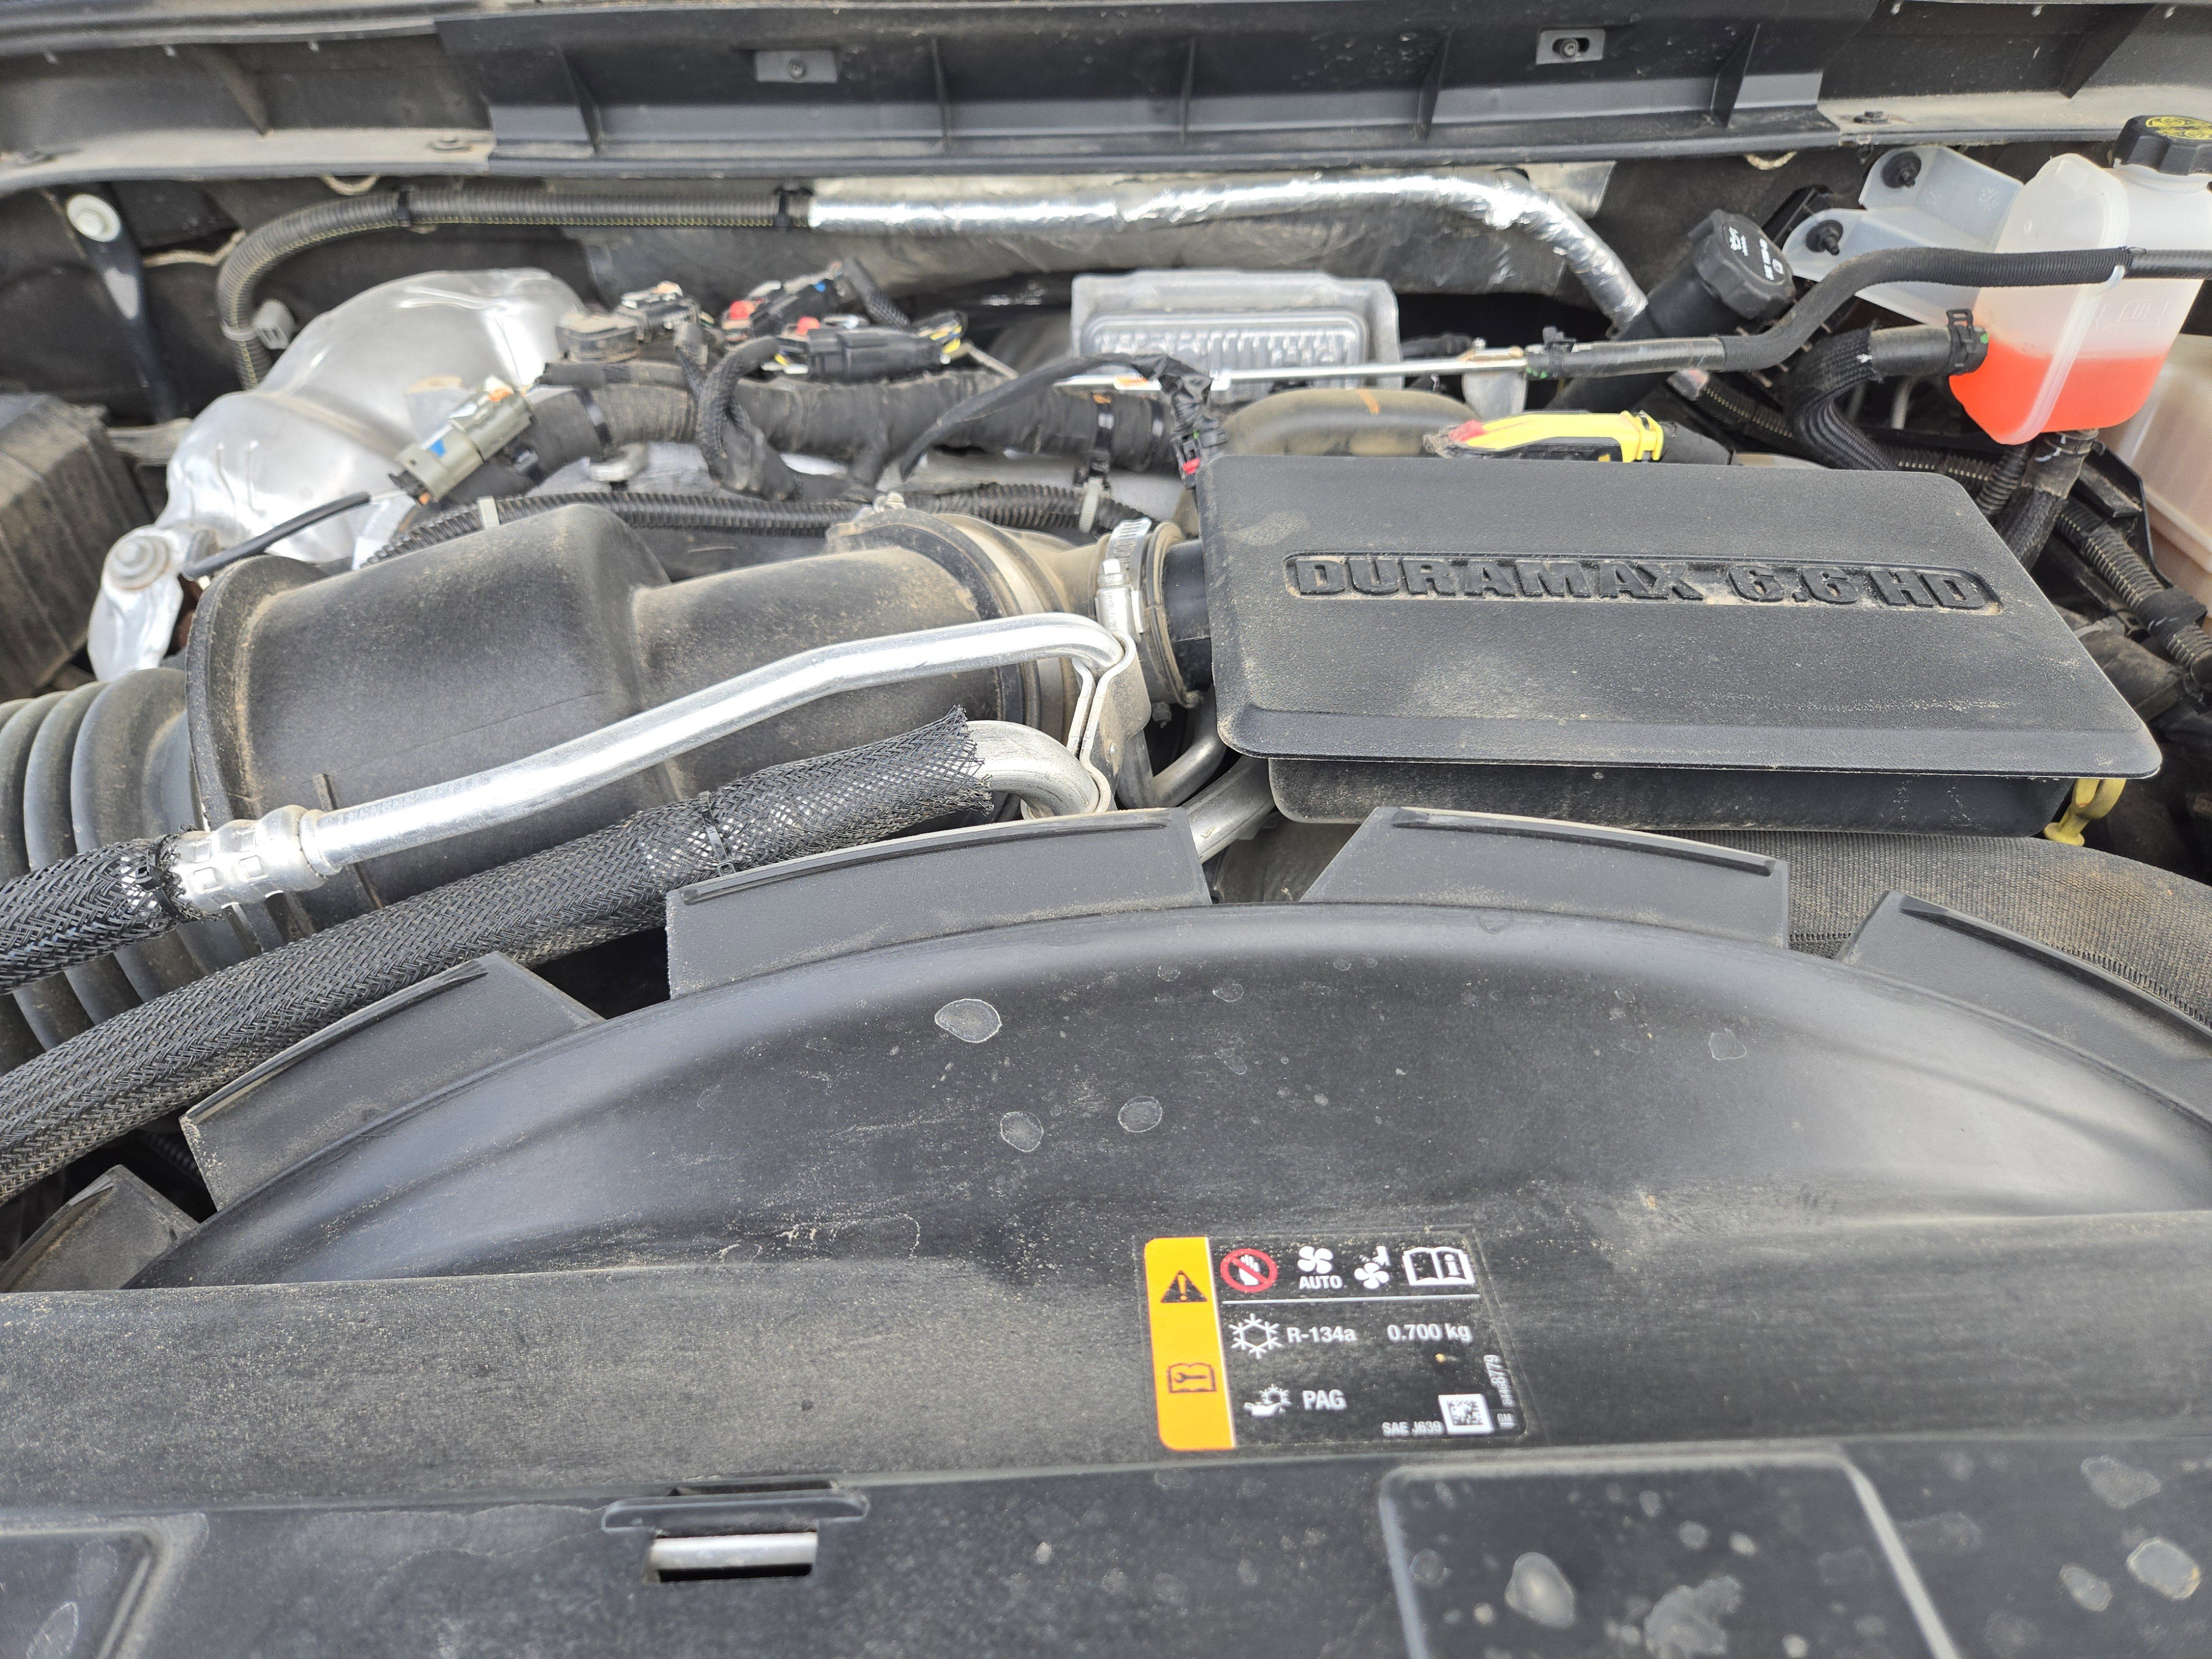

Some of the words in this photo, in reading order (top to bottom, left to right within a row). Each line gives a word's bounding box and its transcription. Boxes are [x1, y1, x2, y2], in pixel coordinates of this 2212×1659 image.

[1296, 558, 1704, 601] DURAMAX
[1726, 565, 1861, 605] 6.6
[1872, 570, 1987, 610] HD
[1299, 1275, 1342, 1290] AUTO
[1287, 1327, 1357, 1343] R-134a
[1387, 1324, 1444, 1342] 0.700
[1445, 1323, 1473, 1343] kg
[1302, 1389, 1347, 1410] PAG
[1497, 1413, 1515, 1423] GM
[1382, 1421, 1410, 1437] SAE
[1411, 1421, 1444, 1436] J639
